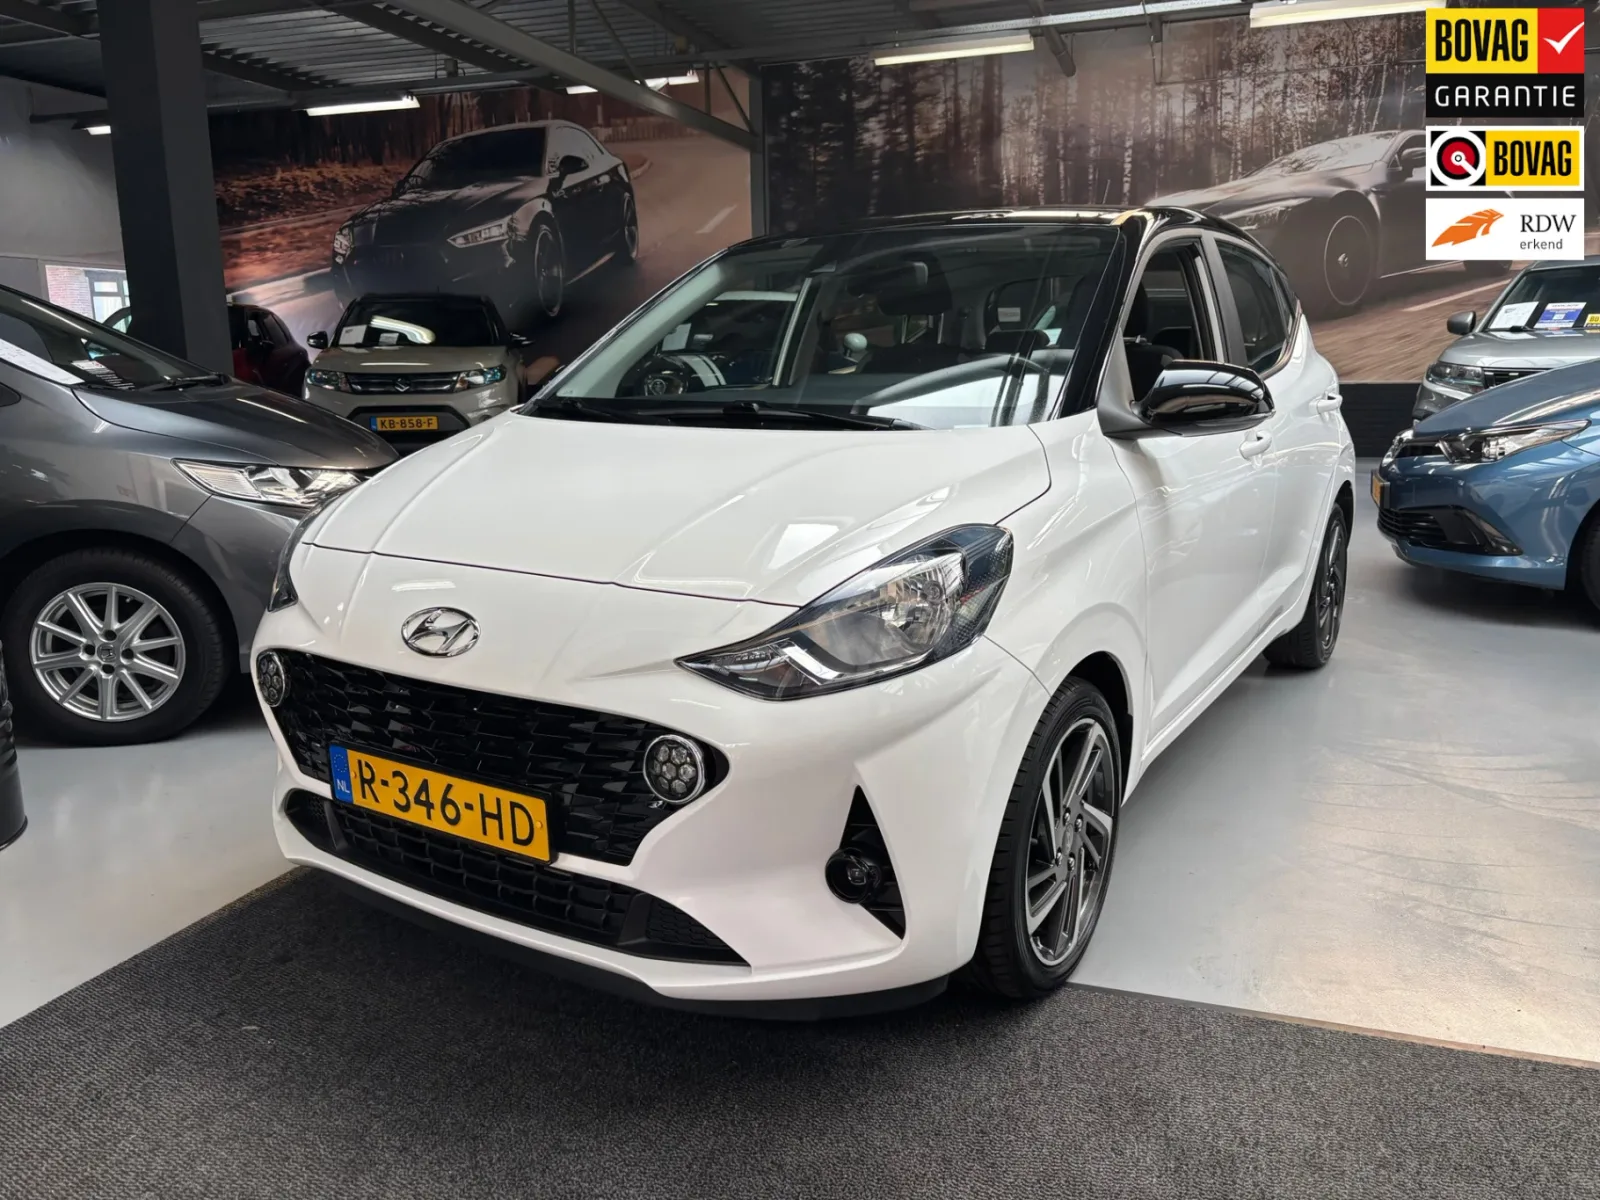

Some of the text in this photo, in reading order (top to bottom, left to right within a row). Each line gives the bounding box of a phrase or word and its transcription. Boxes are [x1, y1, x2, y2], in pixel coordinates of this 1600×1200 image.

[380, 418, 433, 429] KB-858-F
[336, 778, 350, 793] NL
[357, 759, 535, 847] R-346-HD
